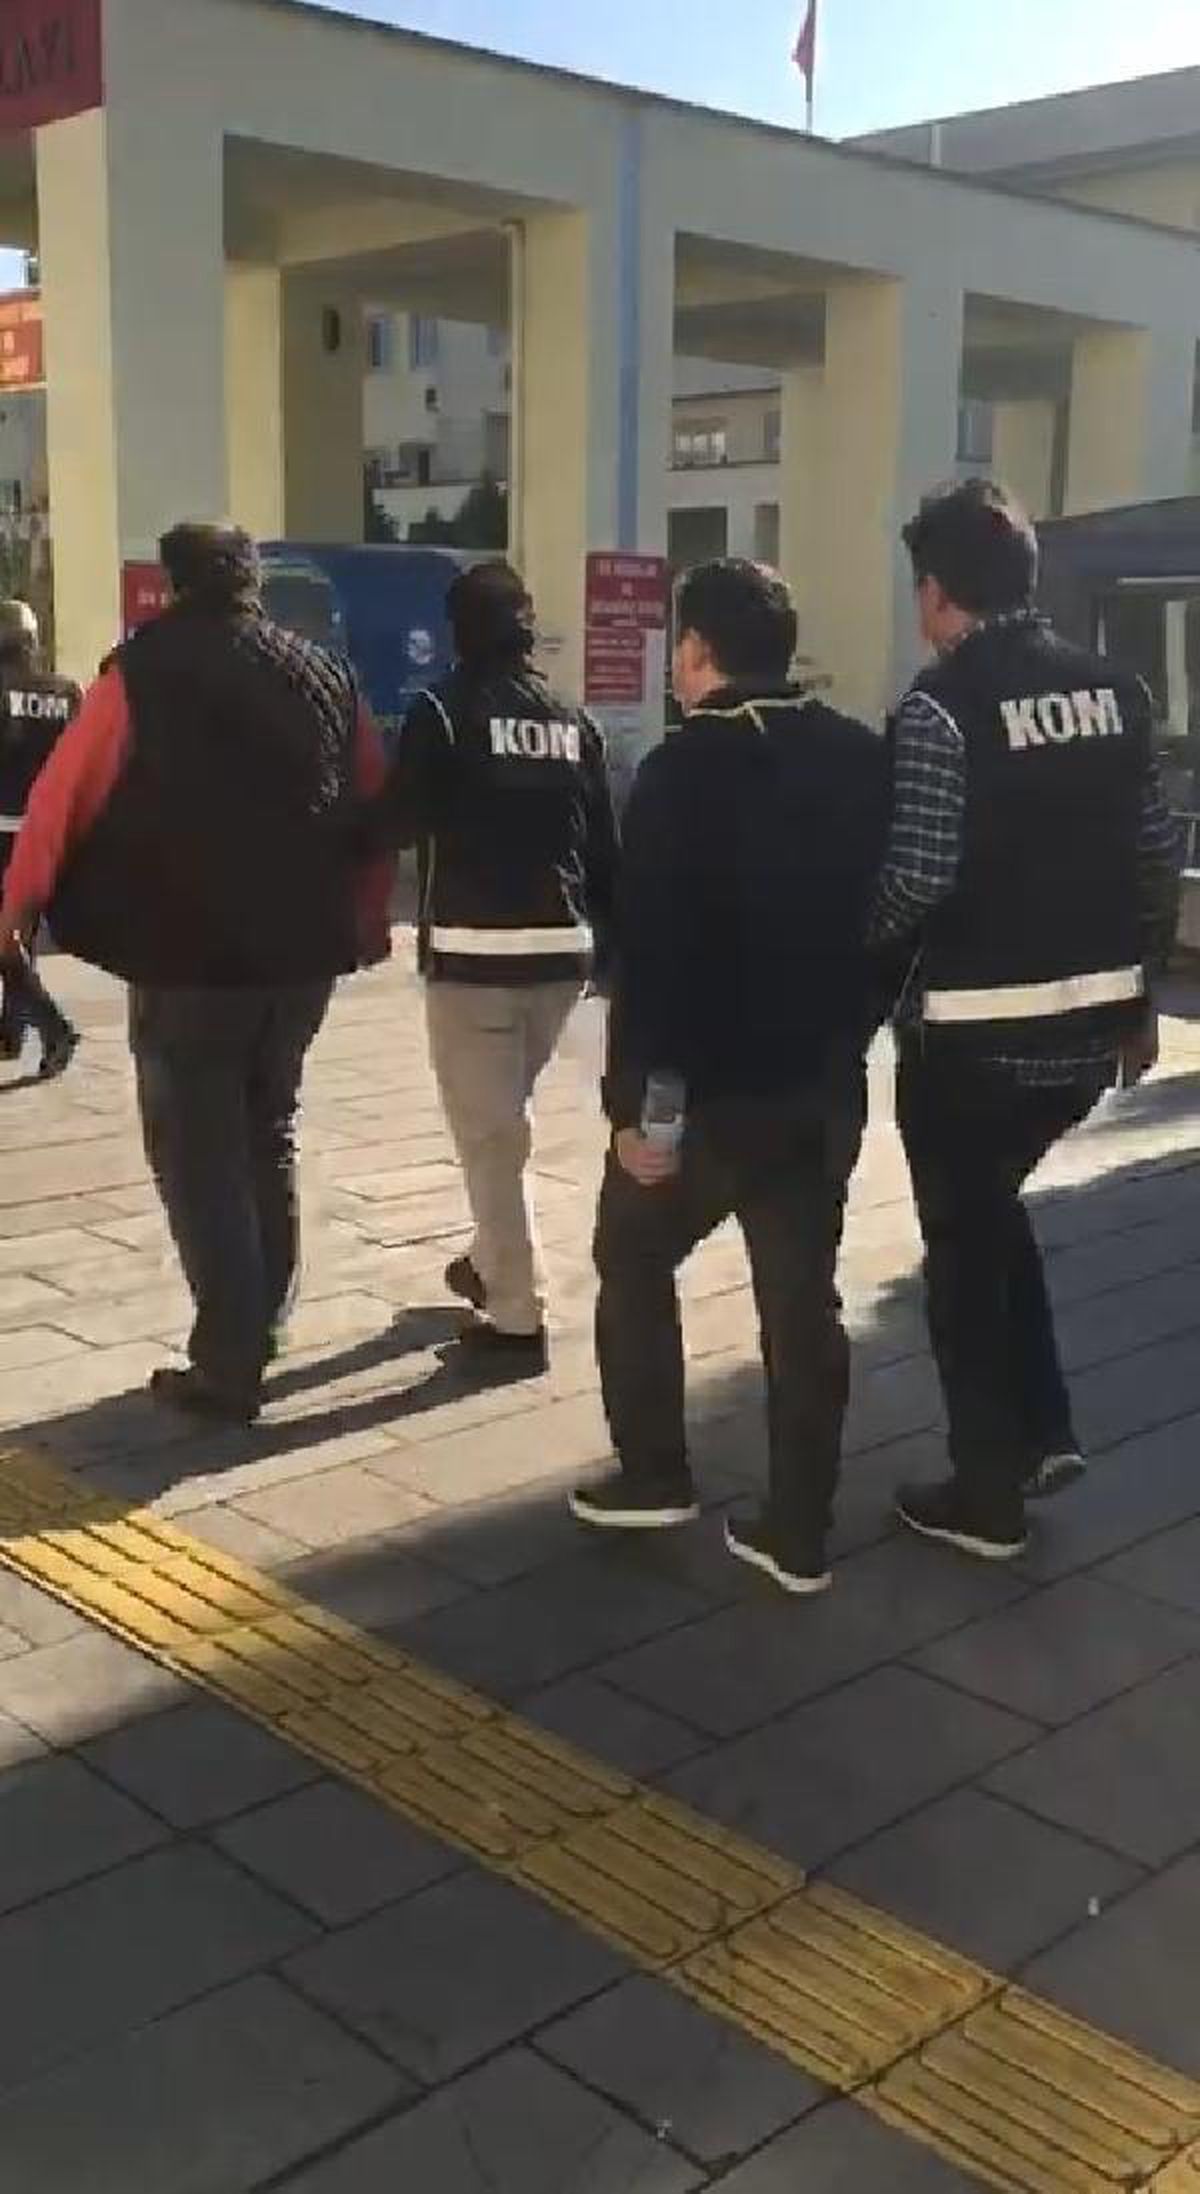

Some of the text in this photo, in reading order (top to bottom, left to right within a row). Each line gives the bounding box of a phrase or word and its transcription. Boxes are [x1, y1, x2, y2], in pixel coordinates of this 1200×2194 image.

[9, 690, 69, 720] KOM
[1000, 688, 1123, 751] KOM
[489, 717, 581, 762] KOM
